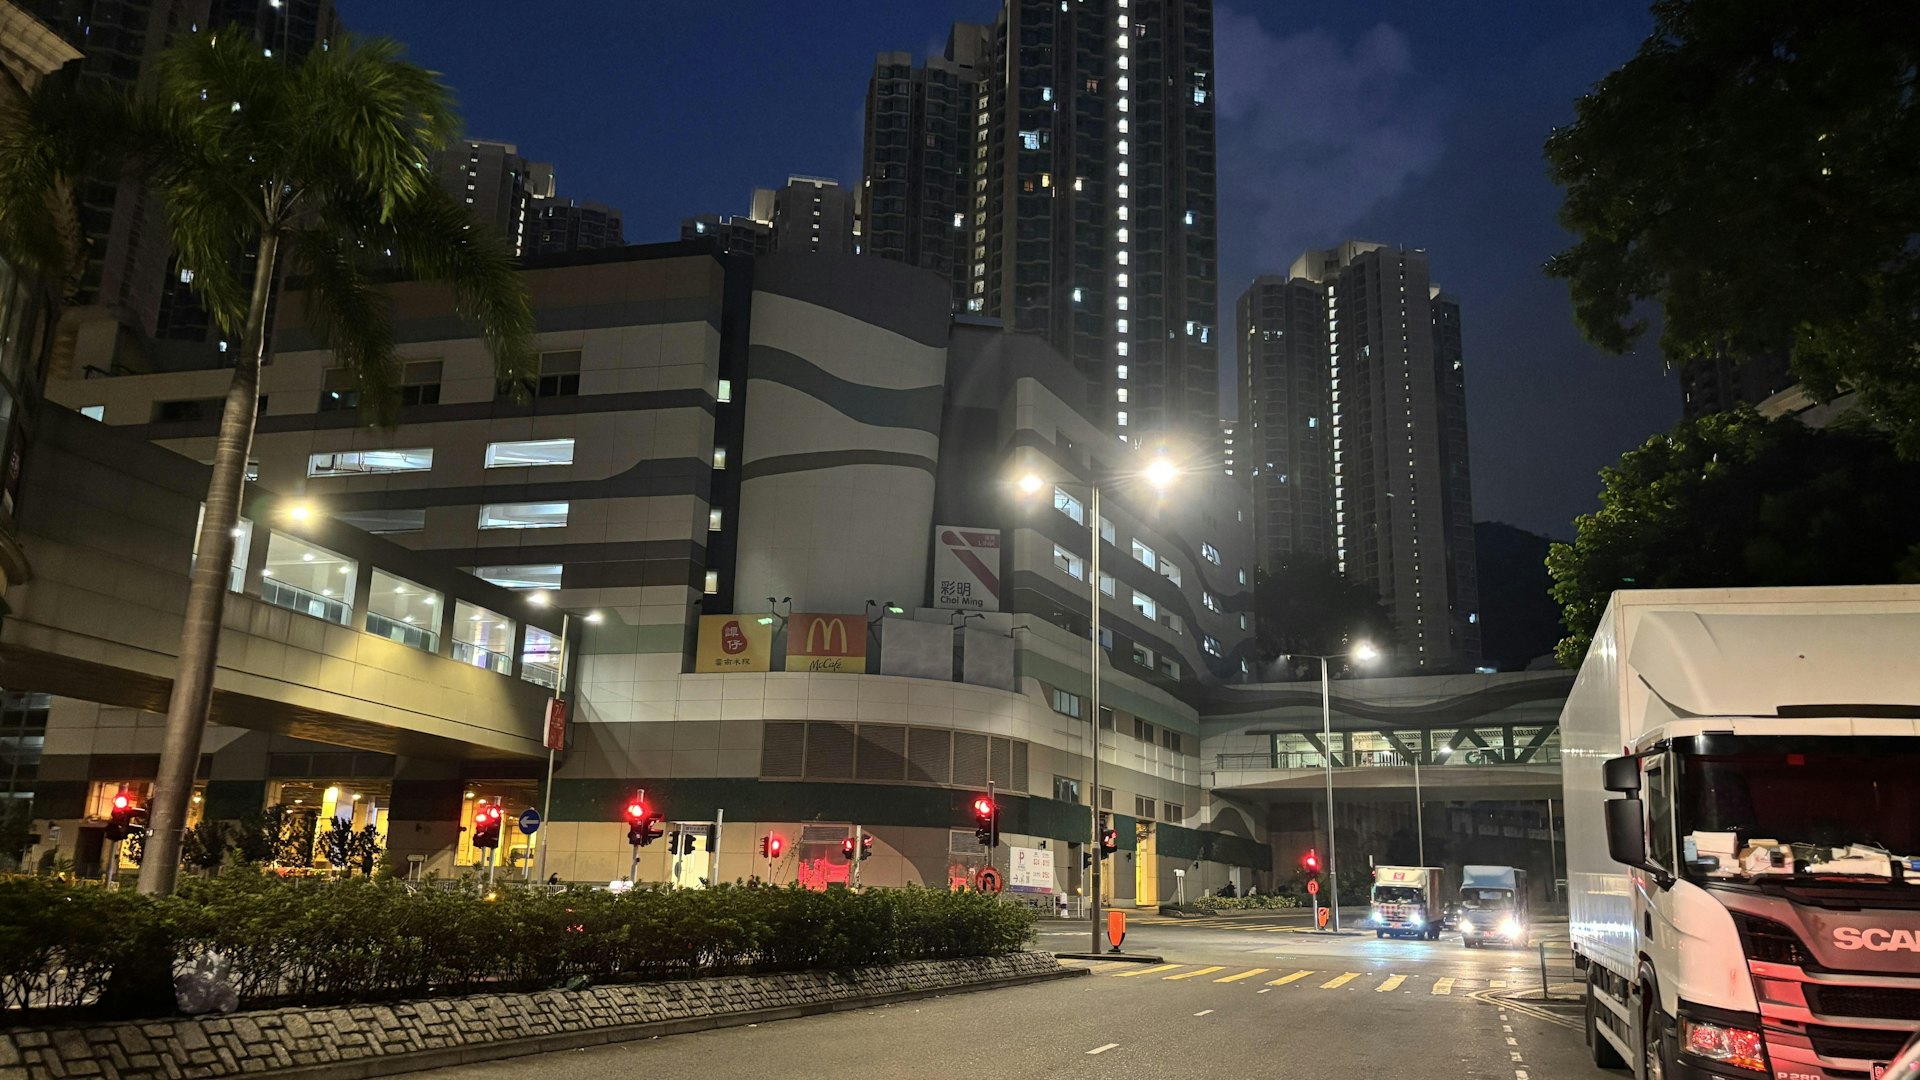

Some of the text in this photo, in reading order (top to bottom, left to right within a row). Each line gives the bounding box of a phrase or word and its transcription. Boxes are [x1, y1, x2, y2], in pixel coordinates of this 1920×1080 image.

[940, 580, 971, 597] 彩明
[940, 595, 984, 608] Choi Ming
[1833, 926, 1920, 953] SCA
[1777, 1072, 1788, 1080] P
